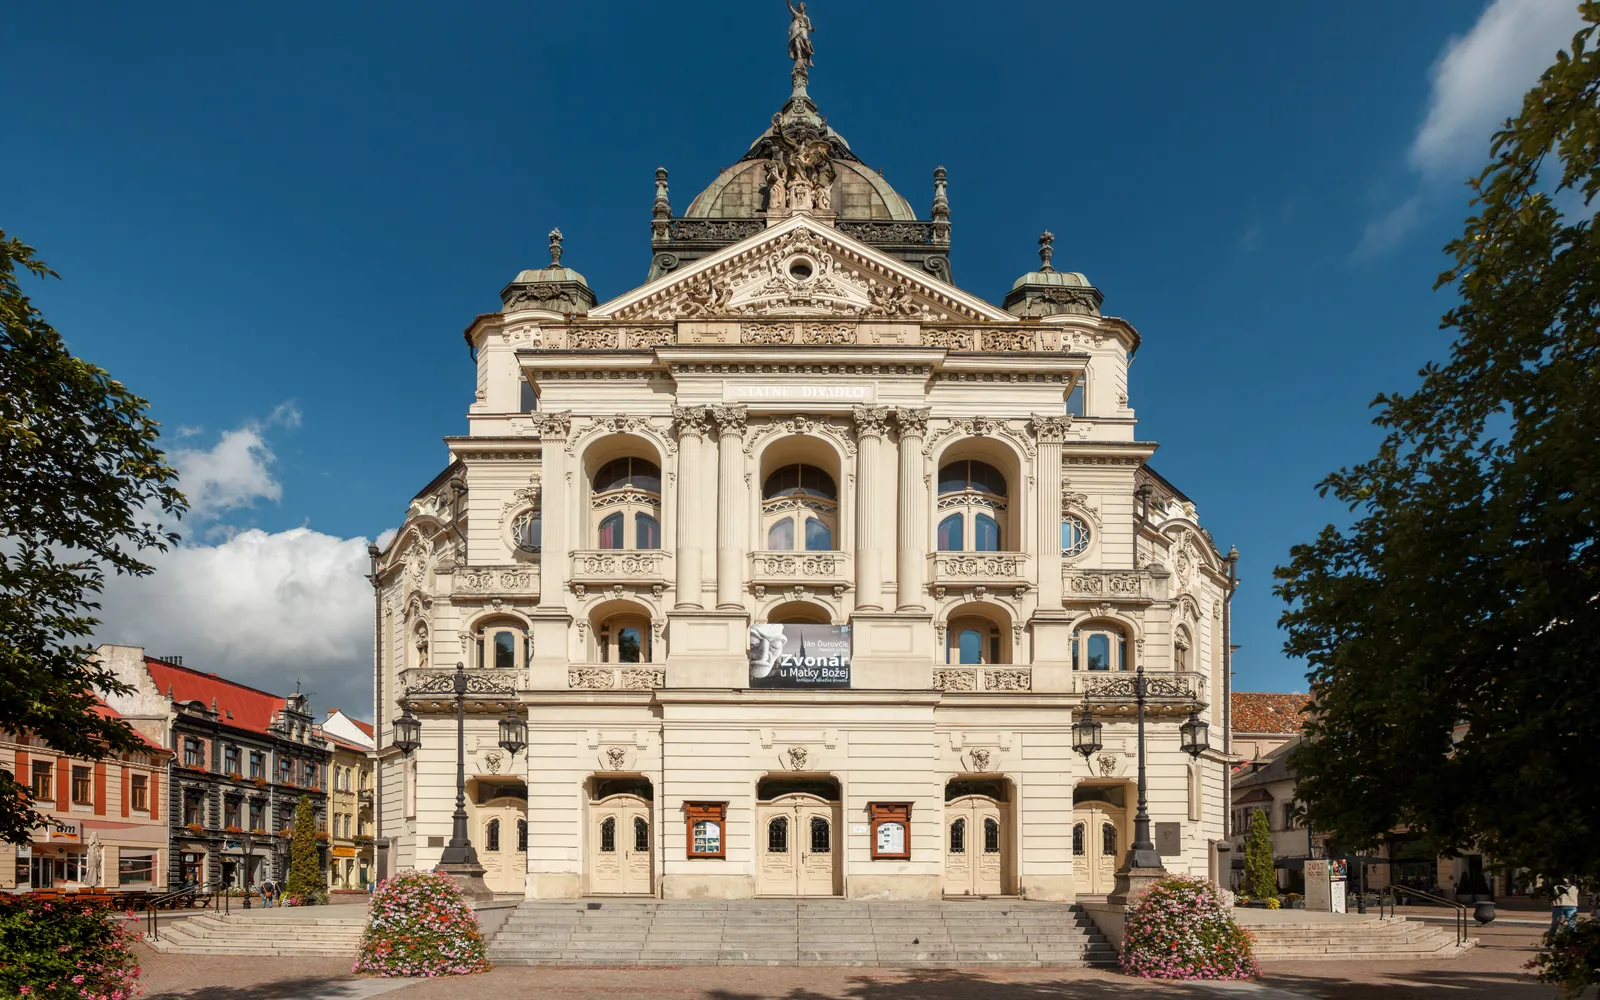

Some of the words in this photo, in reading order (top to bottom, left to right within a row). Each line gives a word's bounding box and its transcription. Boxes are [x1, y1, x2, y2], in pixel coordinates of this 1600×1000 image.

[803, 386, 865, 397] DIVADLO
[804, 640, 815, 648] Ján
[780, 653, 849, 667] Zvonár
[780, 669, 787, 677] u
[789, 668, 819, 679] Matky
[822, 667, 849, 679] Božej
[1308, 863, 1325, 871] 2017
